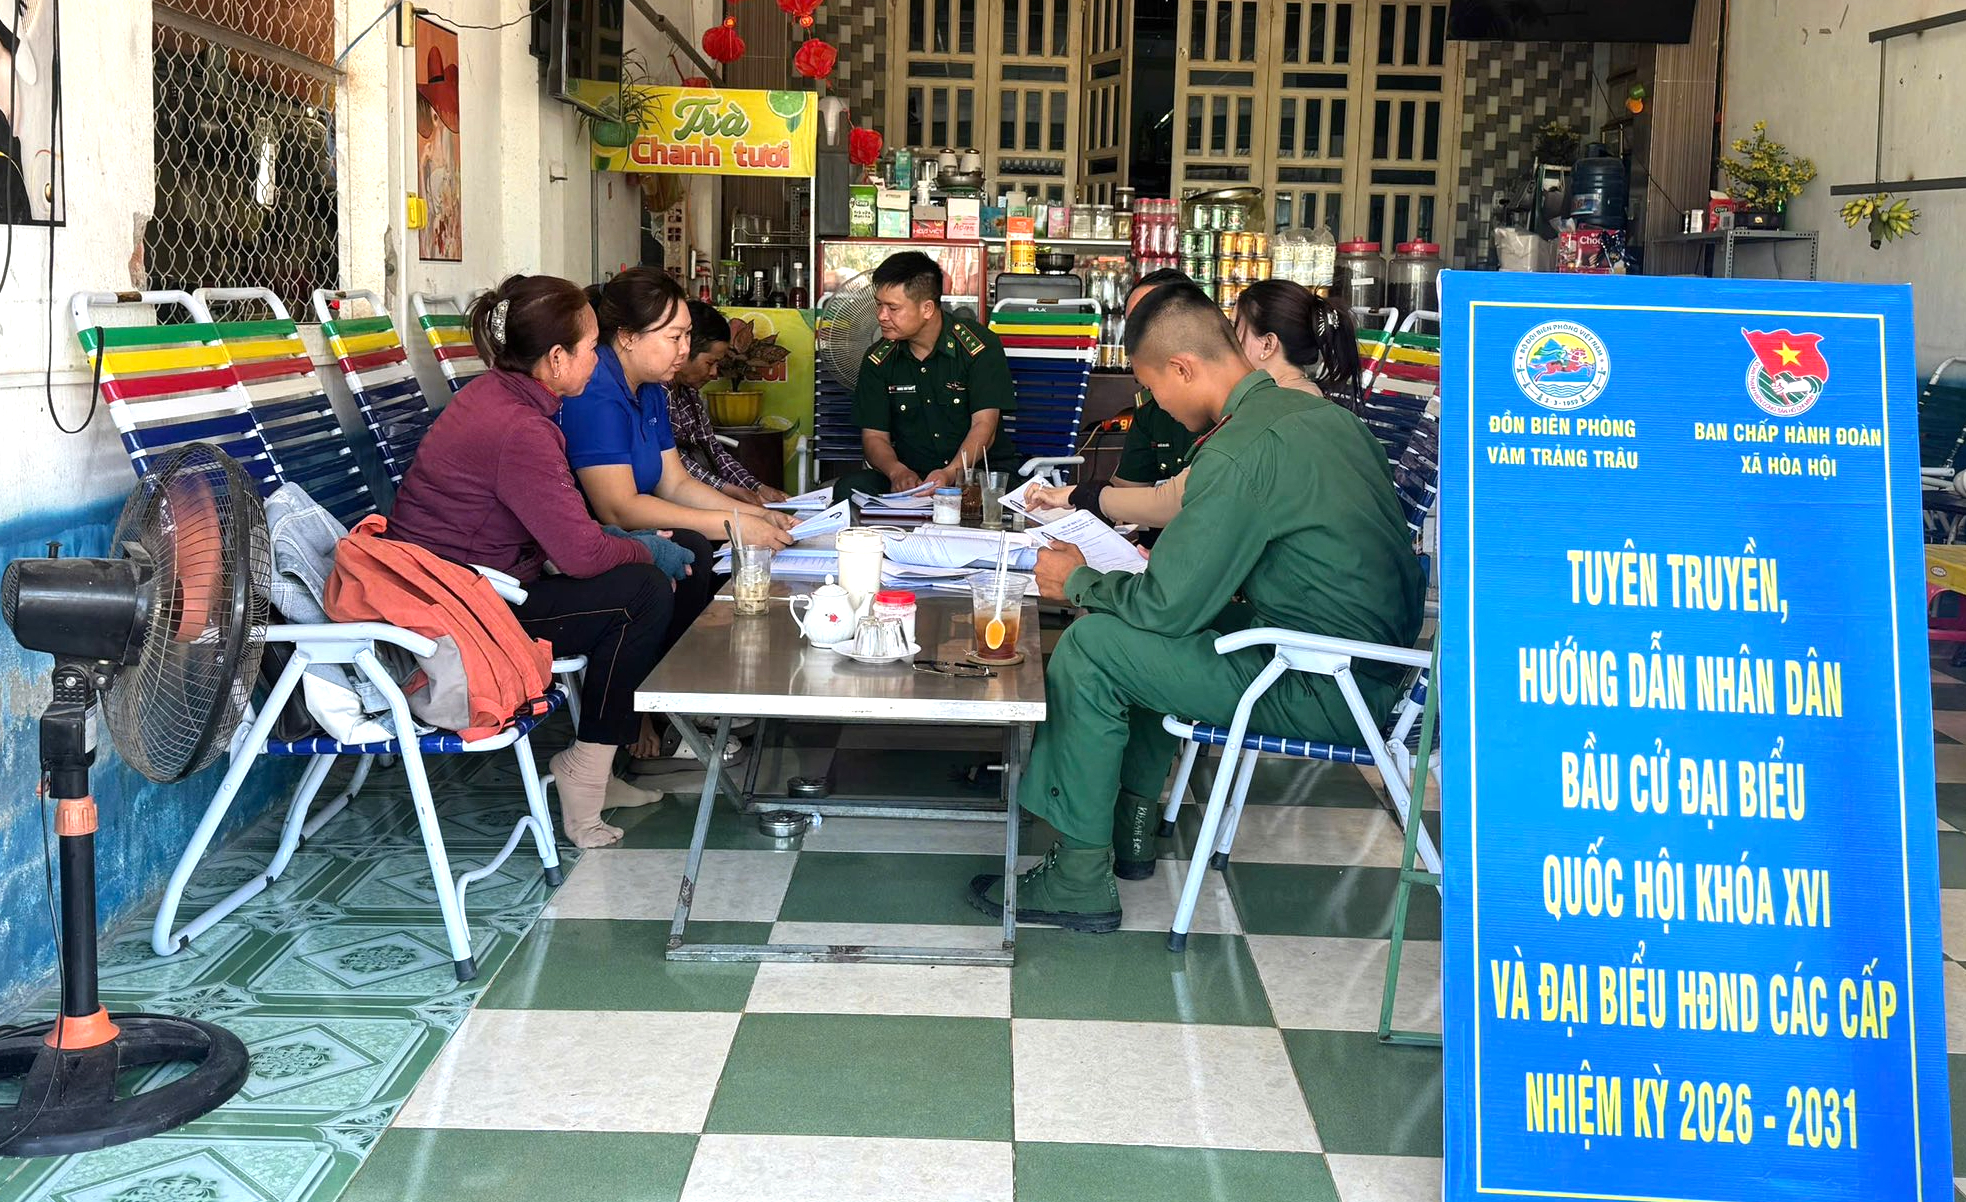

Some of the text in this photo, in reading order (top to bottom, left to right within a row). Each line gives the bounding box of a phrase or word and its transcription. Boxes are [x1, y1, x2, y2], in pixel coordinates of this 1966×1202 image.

[674, 97, 749, 141] Trà
[631, 136, 790, 168] Chanh tươi
[1487, 442, 1639, 469] VÀM TRẢNG TRÂU
[1488, 409, 1636, 438] ĐỒN BIÊN PHÒNG
[1695, 417, 1882, 446] BAN CHẤP HÀNH ĐOÀN
[1741, 452, 1836, 480] XÃ HÒA HỘI
[1567, 537, 1787, 623] TUYÊN TRUYỀN,
[1519, 631, 1842, 717] HƯỚNG DẪN NHÂN DÂN
[1562, 732, 1805, 829] BẦU CỬ ĐẠI BIỂU
[1543, 837, 1830, 934] QUỐC HỘI KHÓA XVI
[1491, 941, 1896, 1039] VÀ ĐẠI BIỂU HĐND CÁC CẤP
[1526, 1060, 1621, 1149] NHIỆM
[1634, 1064, 1668, 1138] KỲ
[1680, 1081, 1752, 1144] 2026
[1787, 1086, 1857, 1149] 2031
